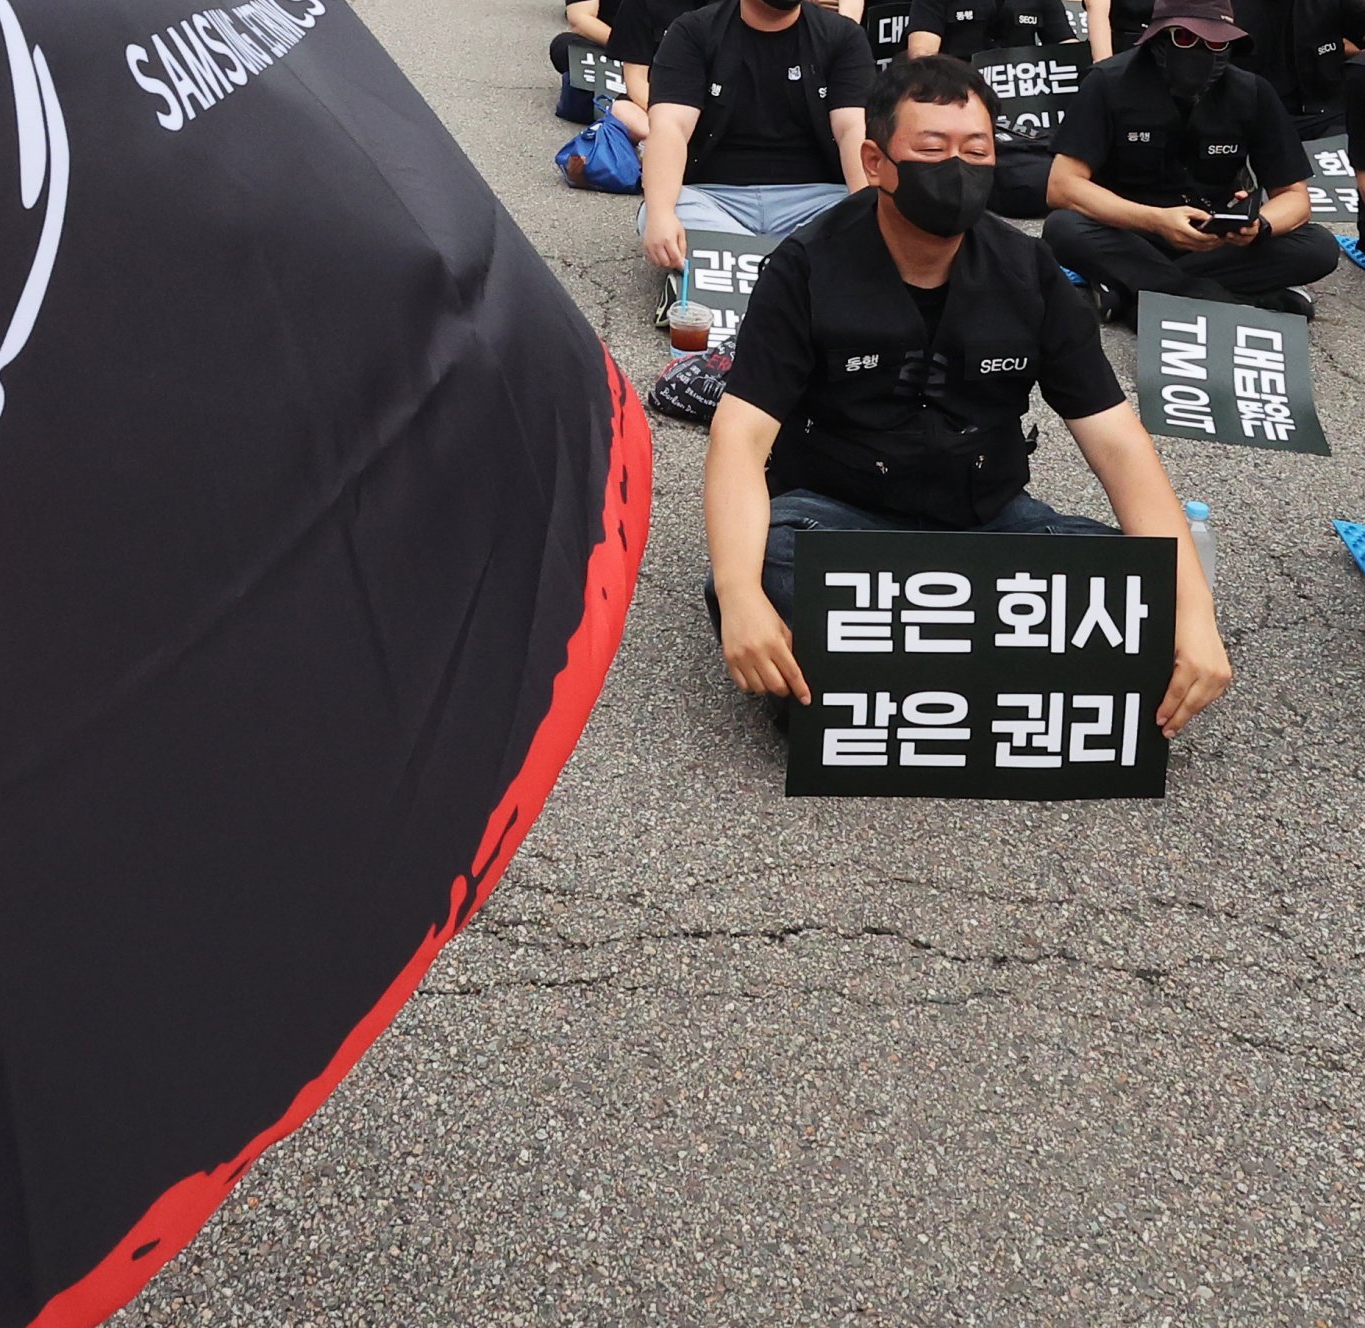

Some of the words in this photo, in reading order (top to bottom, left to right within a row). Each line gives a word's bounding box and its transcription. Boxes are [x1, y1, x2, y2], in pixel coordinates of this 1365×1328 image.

[1018, 14, 1038, 25] SECU
[1127, 132, 1151, 142] 동행
[1207, 144, 1238, 155] SECU
[845, 354, 879, 372] 동행
[1161, 316, 1208, 380] TM
[980, 357, 1028, 374] SECU
[1233, 325, 1296, 441] 대답없는
[1161, 384, 1216, 434] OUT
[825, 572, 975, 653] 같은
[994, 572, 1148, 654] 회사
[822, 691, 971, 767] 같은
[991, 692, 1140, 768] 권리
